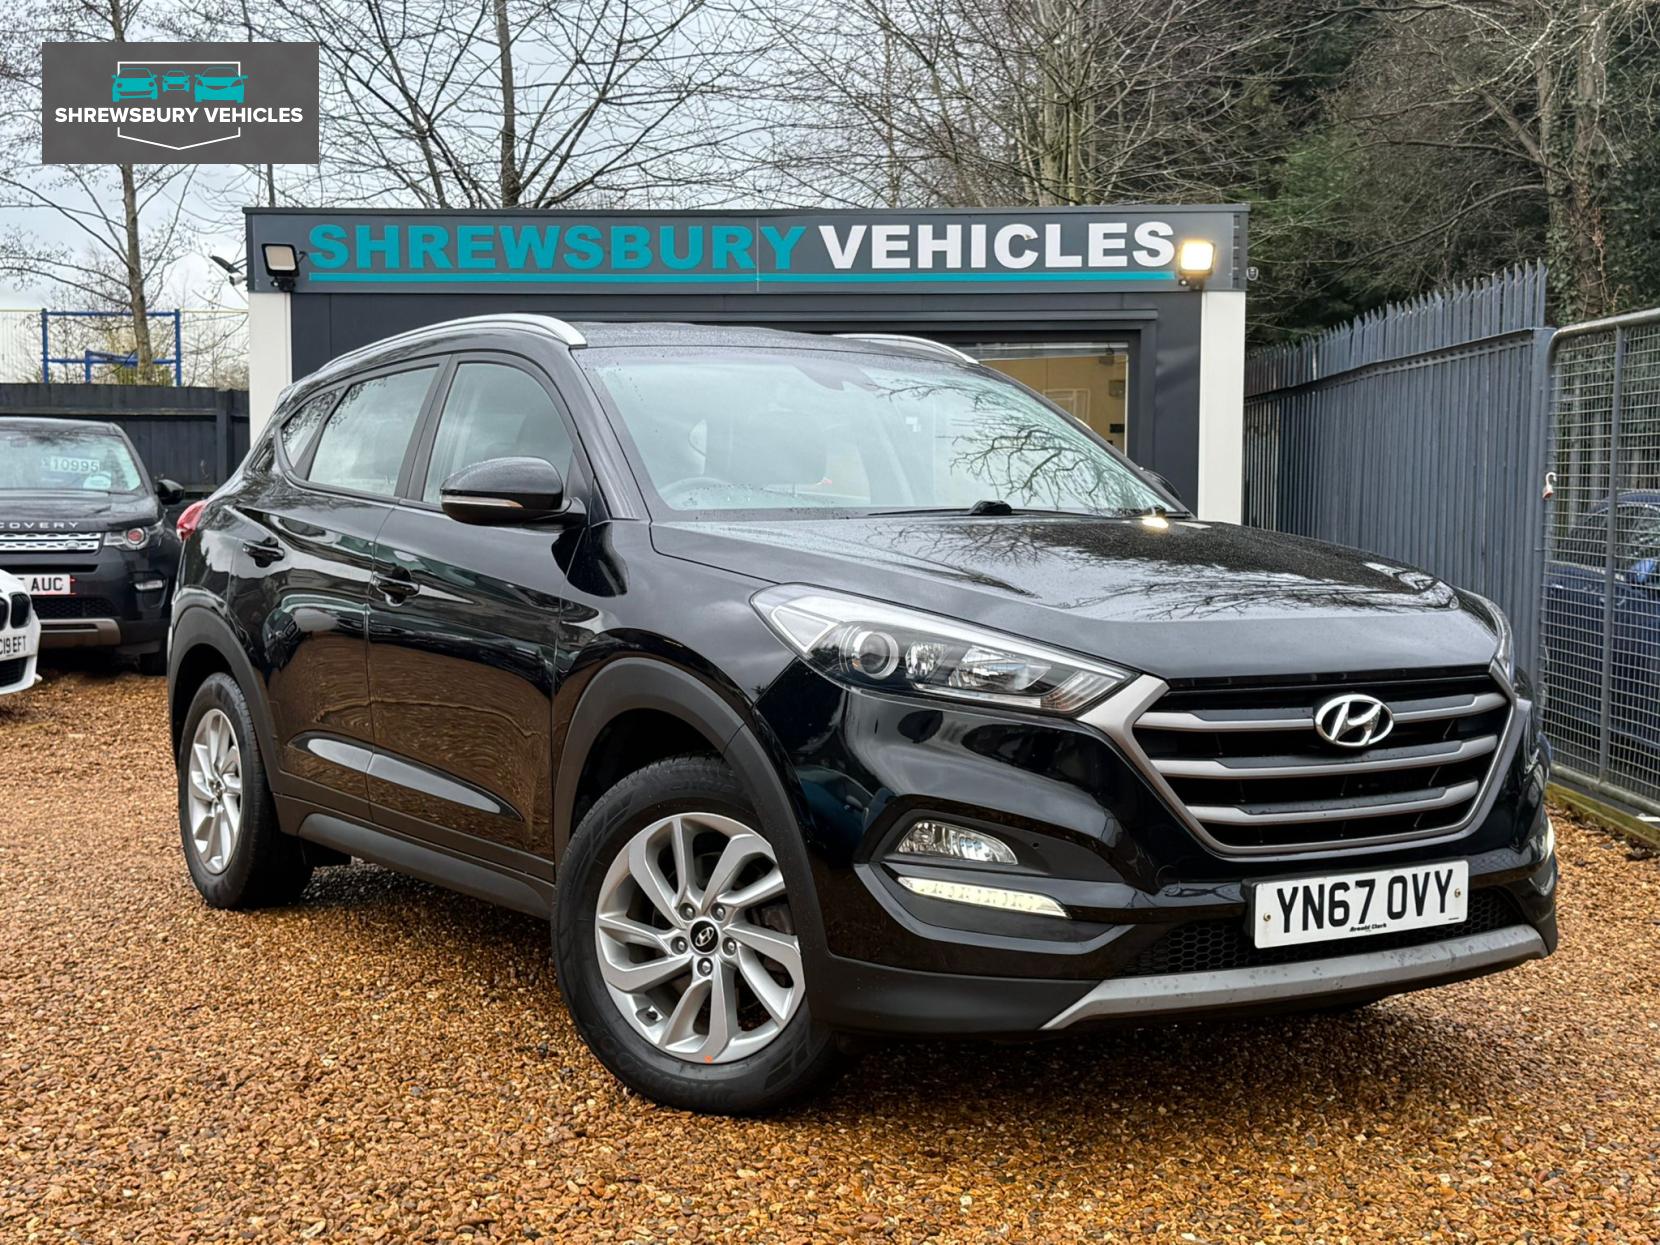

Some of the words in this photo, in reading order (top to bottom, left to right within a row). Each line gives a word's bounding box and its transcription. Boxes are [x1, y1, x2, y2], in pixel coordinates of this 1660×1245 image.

[308, 223, 806, 271] SHREWSBURY
[819, 221, 1175, 270] VEHICLES
[31, 577, 63, 592] AUC
[13, 635, 26, 653] EFT
[1276, 878, 1376, 934] YN67
[1387, 868, 1454, 920] OVY
